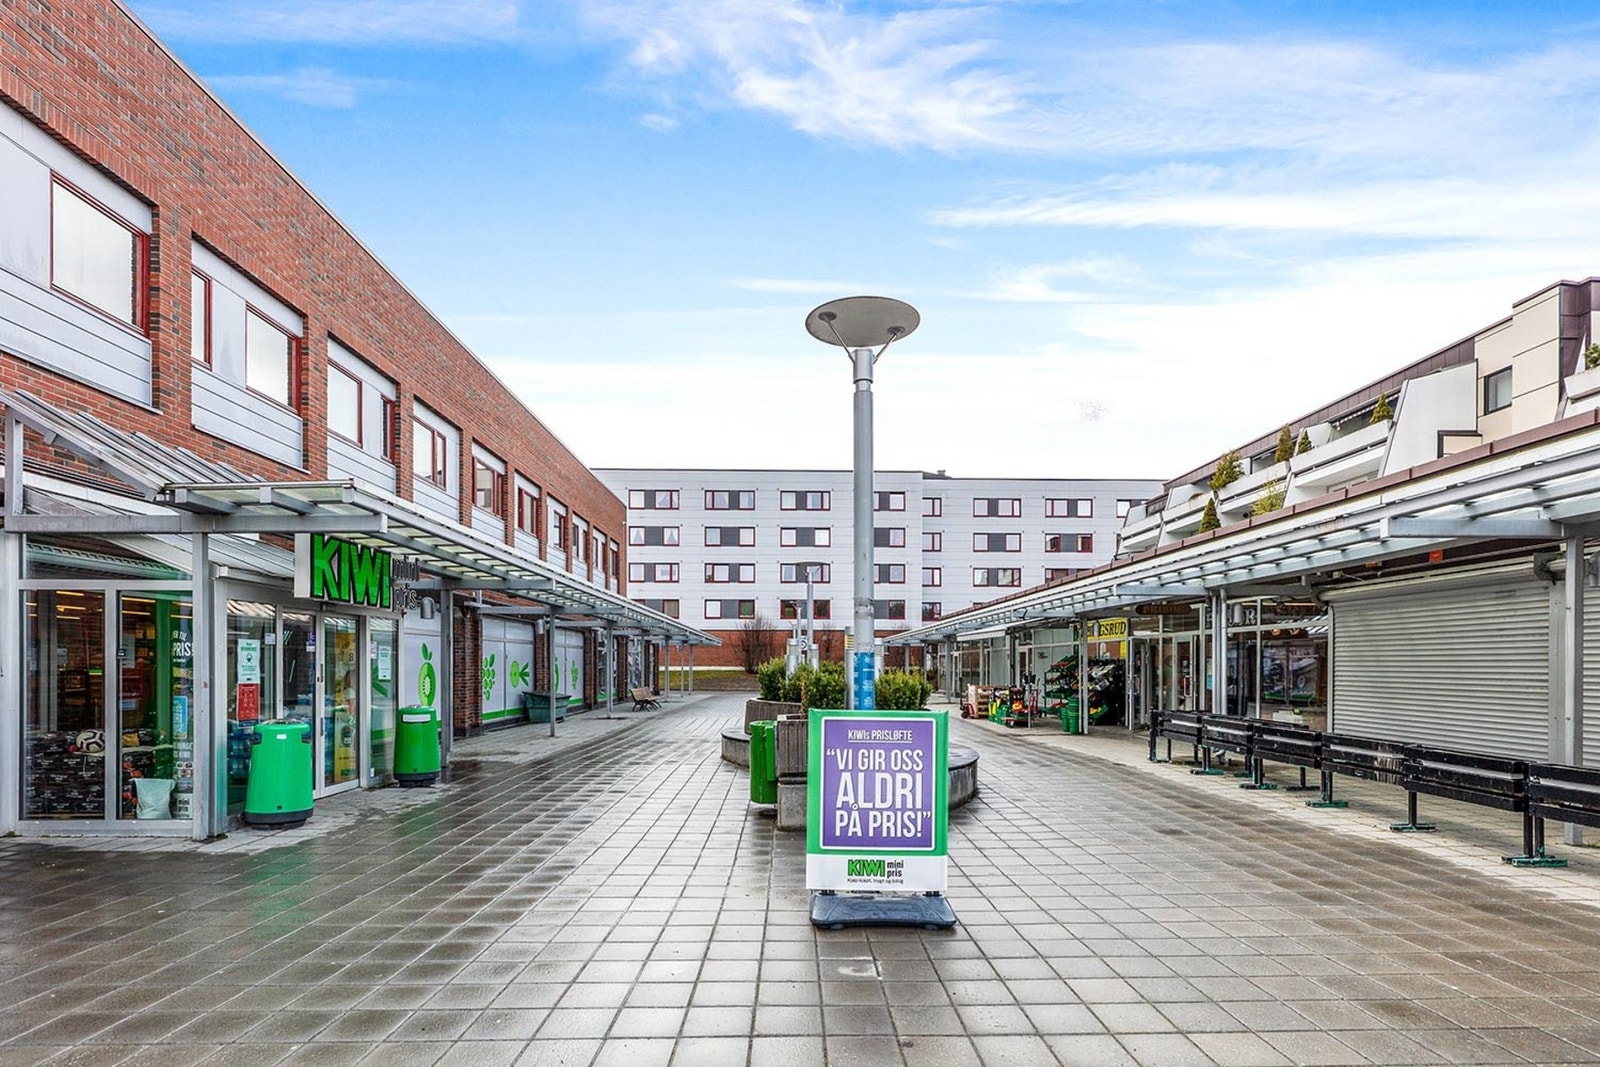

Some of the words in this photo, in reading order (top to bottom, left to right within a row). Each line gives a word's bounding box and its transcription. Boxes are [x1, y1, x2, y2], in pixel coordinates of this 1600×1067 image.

[311, 533, 390, 608] KIWI
[393, 583, 416, 613] pris
[848, 730, 871, 740] KIWIs
[871, 730, 913, 741] PRISLØFTE
[858, 749, 887, 771] GIR
[890, 749, 923, 771] OSS
[836, 772, 922, 809] ALDRI
[835, 804, 862, 837] PÅ
[847, 859, 885, 877] KIWI
[887, 860, 904, 869] mini
[887, 868, 903, 879] pris
